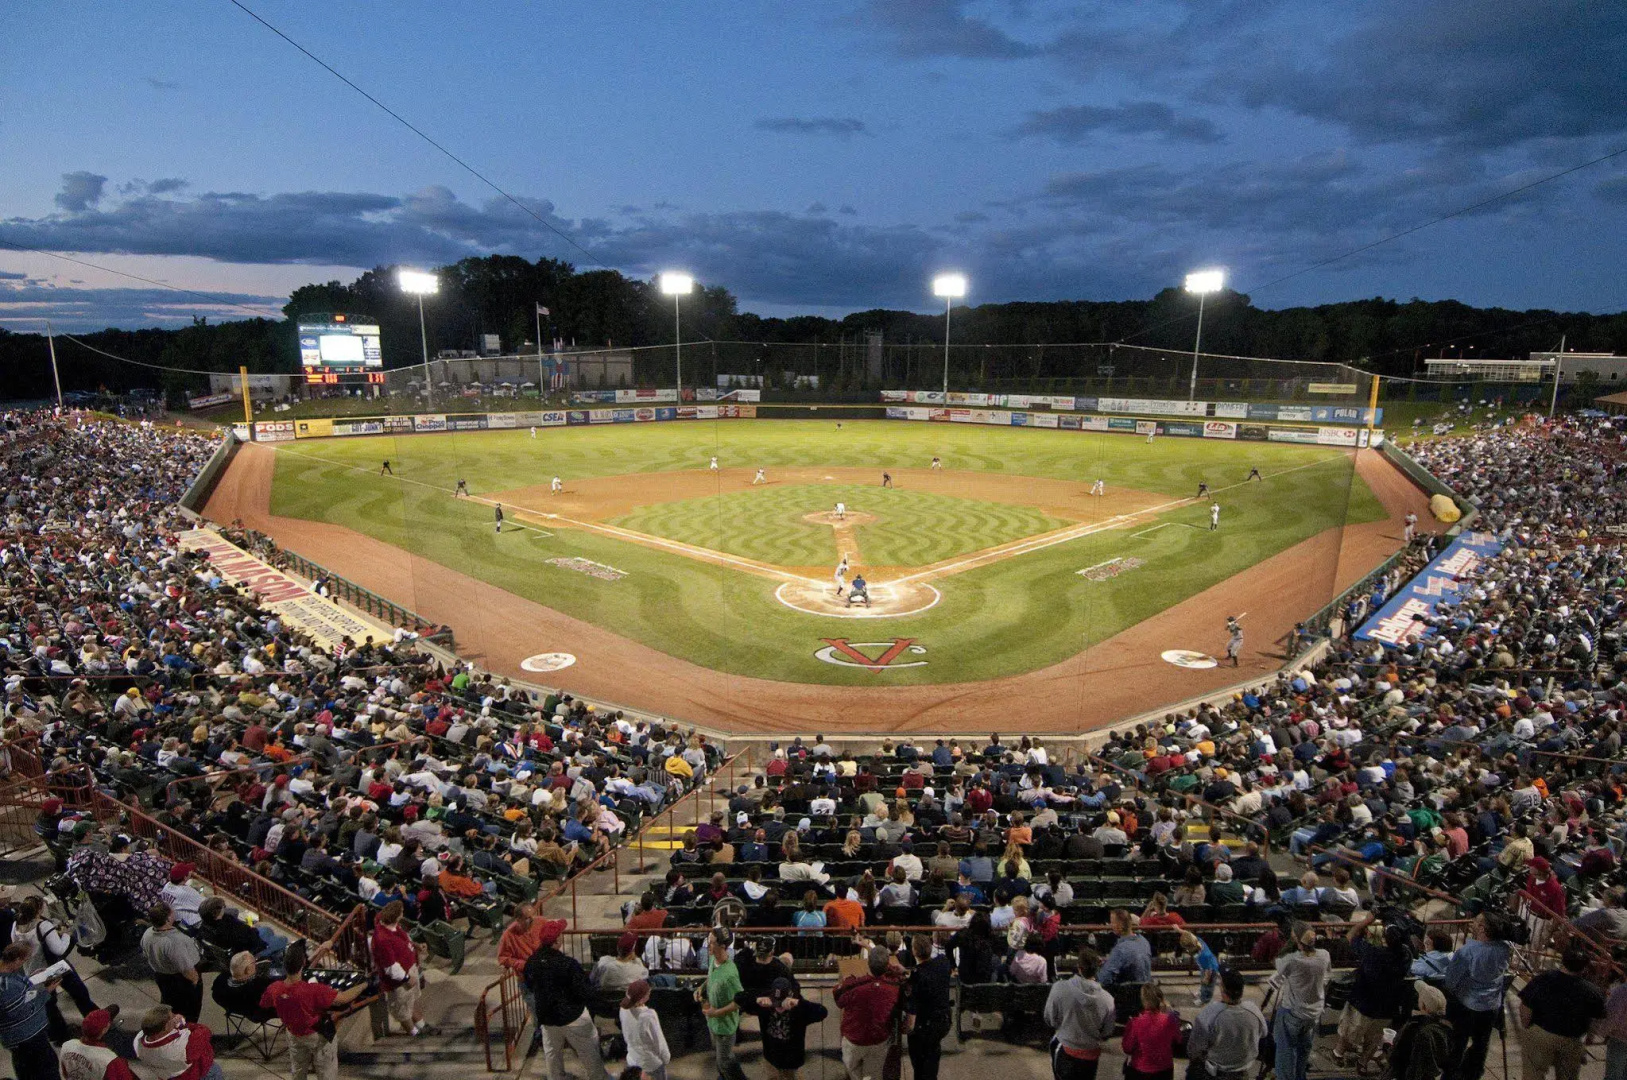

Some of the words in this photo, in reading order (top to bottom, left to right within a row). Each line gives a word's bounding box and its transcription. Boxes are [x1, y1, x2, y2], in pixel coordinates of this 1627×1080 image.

[1334, 409, 1358, 419] POLAR
[255, 423, 294, 432] PODS
[1320, 428, 1341, 438] HSBC
